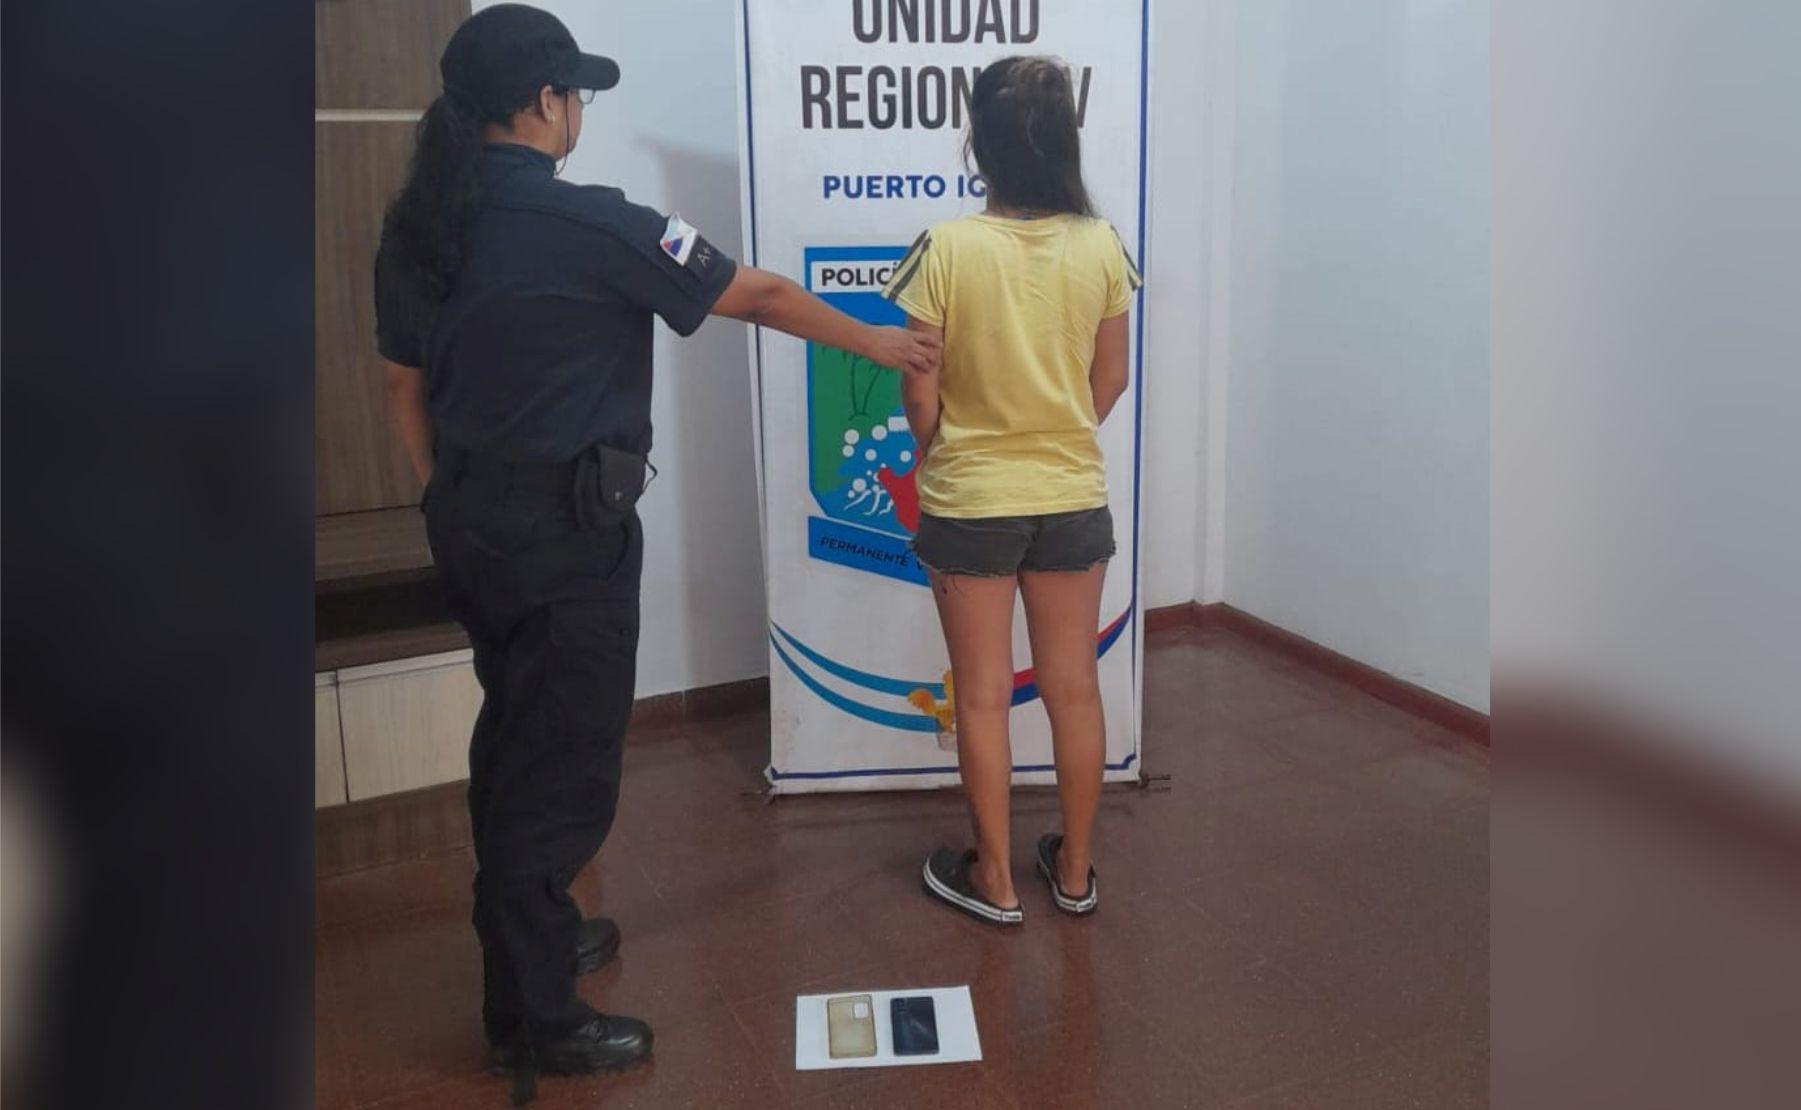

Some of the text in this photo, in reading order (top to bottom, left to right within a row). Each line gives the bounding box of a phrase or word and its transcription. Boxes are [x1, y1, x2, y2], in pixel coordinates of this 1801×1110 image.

[853, 0, 1039, 44] UNIDAD
[801, 65, 981, 129] REGION
[823, 174, 946, 199] PUERTO
[821, 261, 898, 286] POLIC
[820, 536, 909, 567] PERMANENTE
